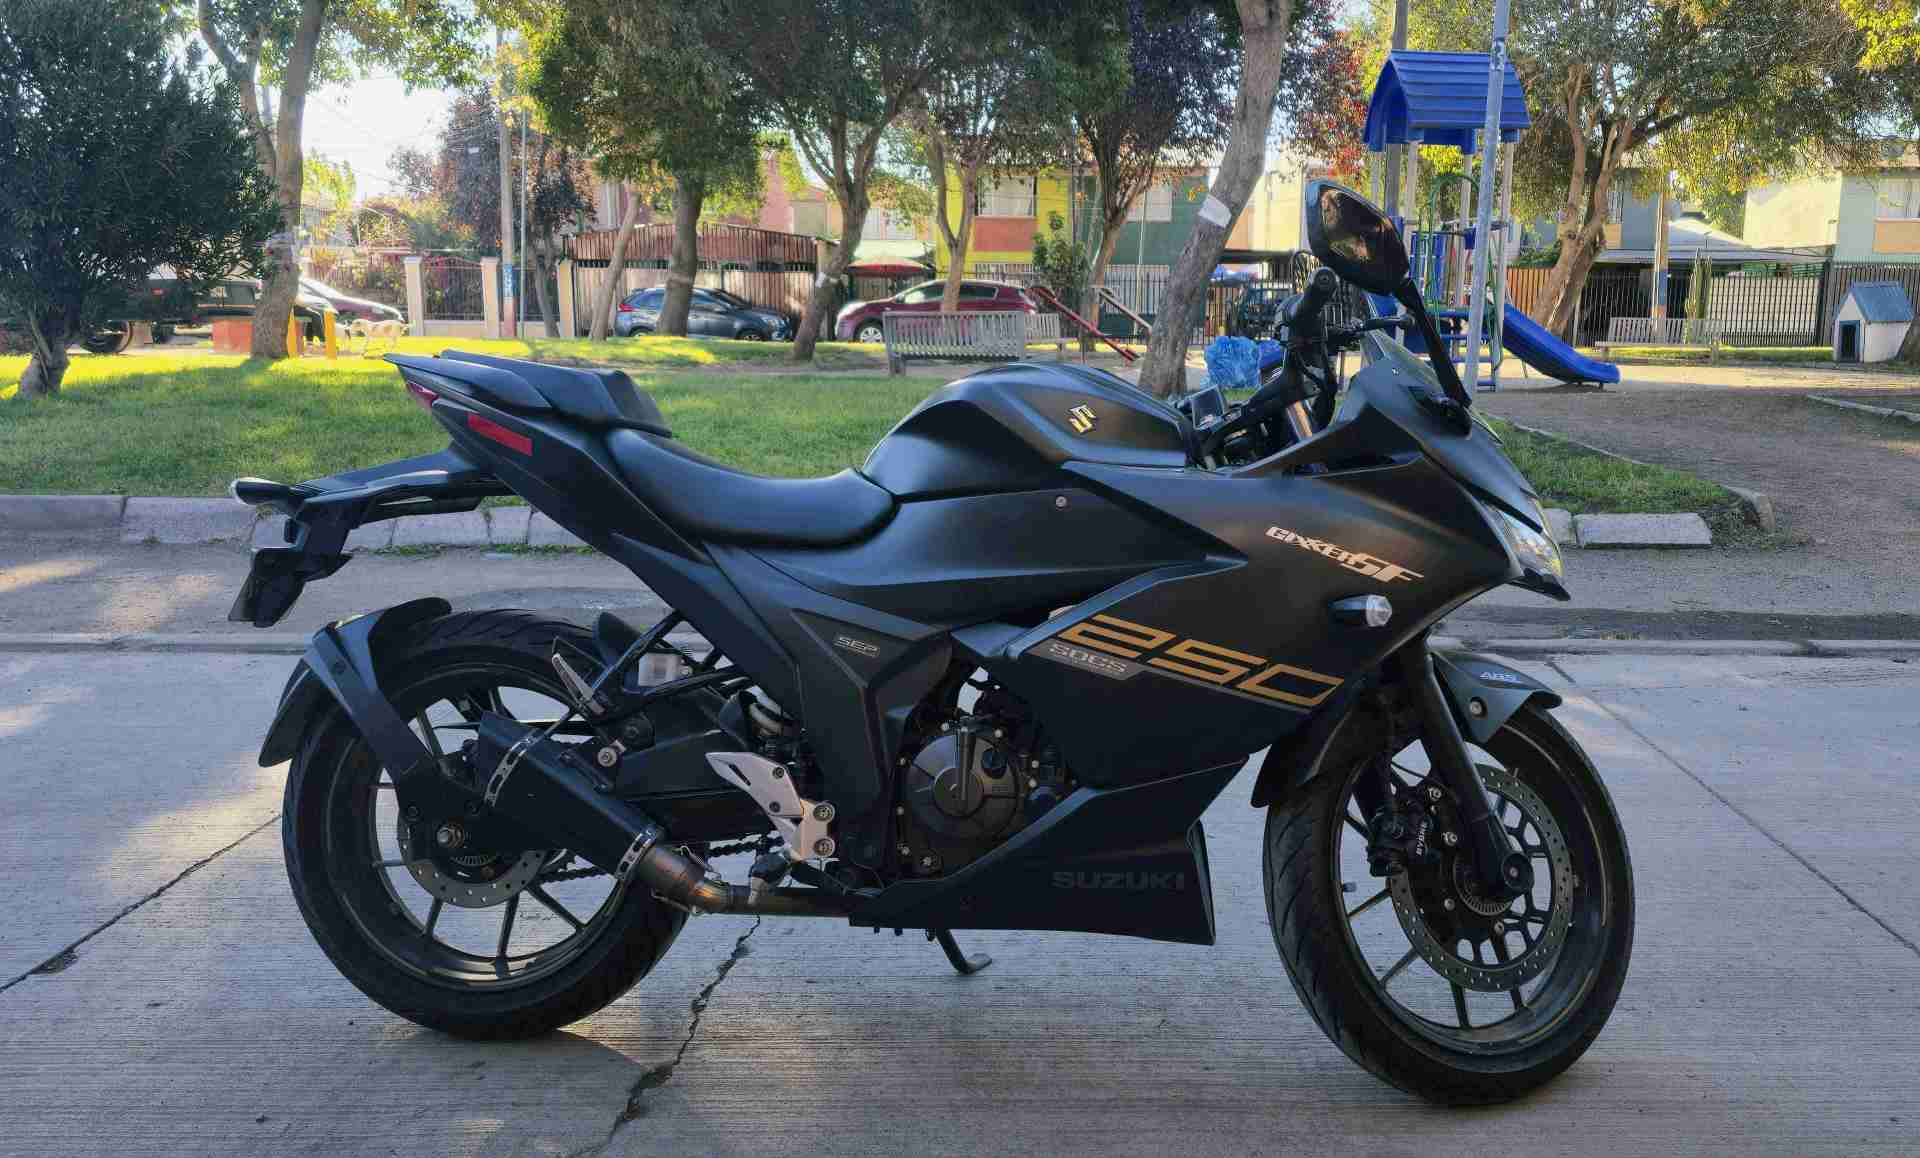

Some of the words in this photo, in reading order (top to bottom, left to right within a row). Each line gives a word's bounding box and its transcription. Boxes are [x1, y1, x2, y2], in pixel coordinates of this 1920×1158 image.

[1339, 552, 1424, 583] SF
[1057, 613, 1345, 706] 250
[1051, 871, 1185, 889] SUZUKI
